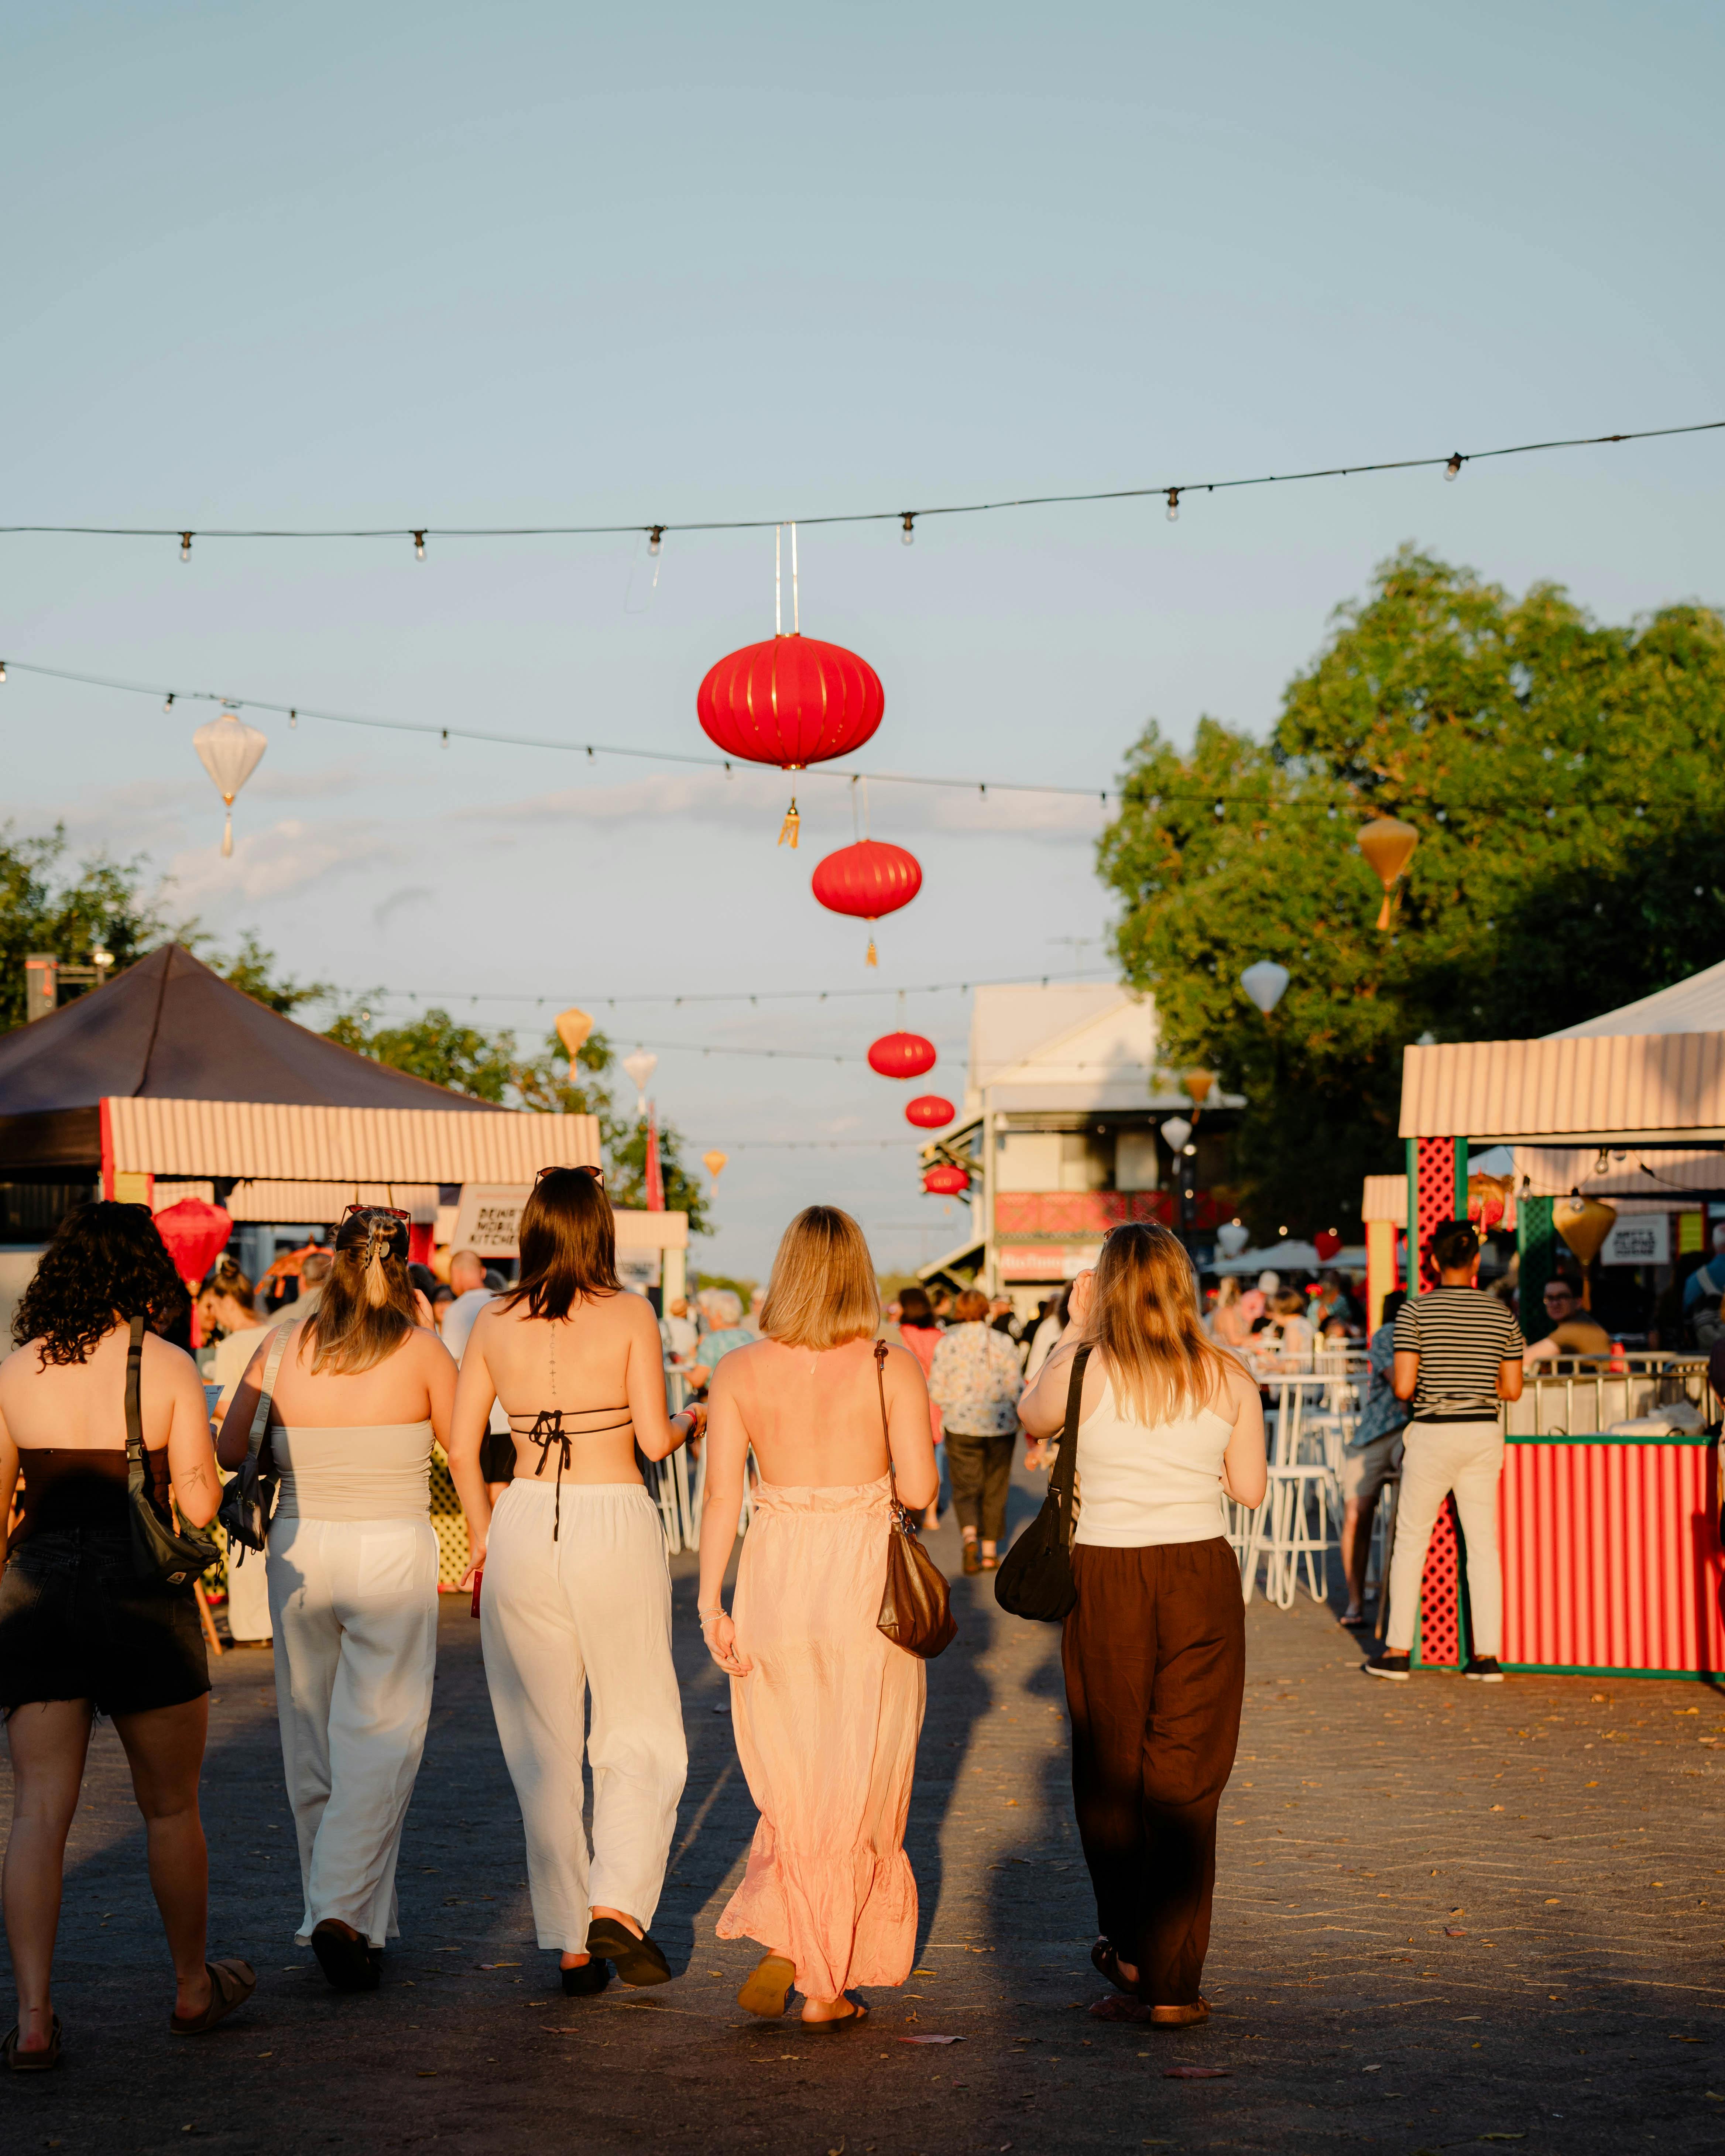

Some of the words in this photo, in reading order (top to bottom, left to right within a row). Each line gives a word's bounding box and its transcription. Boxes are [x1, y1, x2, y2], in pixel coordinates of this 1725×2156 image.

[477, 1221, 519, 1231] MOBIL
[469, 1234, 519, 1245] KITCHE
[255, 1400, 270, 1422] POPPY
